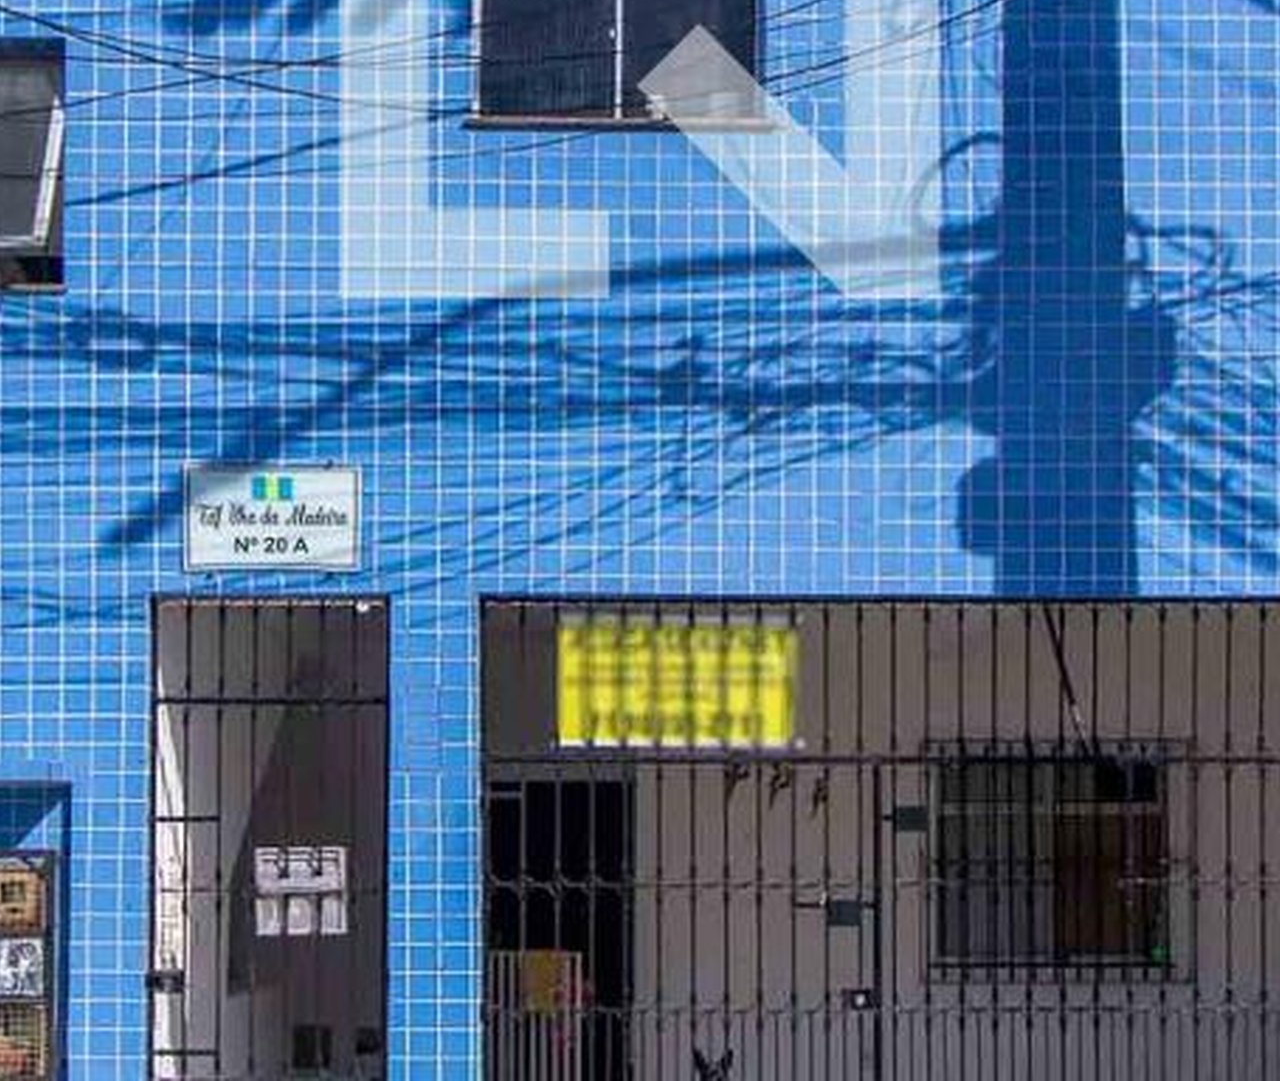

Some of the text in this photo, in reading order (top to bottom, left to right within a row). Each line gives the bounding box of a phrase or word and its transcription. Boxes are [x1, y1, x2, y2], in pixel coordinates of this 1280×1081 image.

[260, 506, 279, 526] da
[284, 503, 348, 526] Madeira
[263, 536, 288, 554] 20
[293, 536, 309, 554] A
